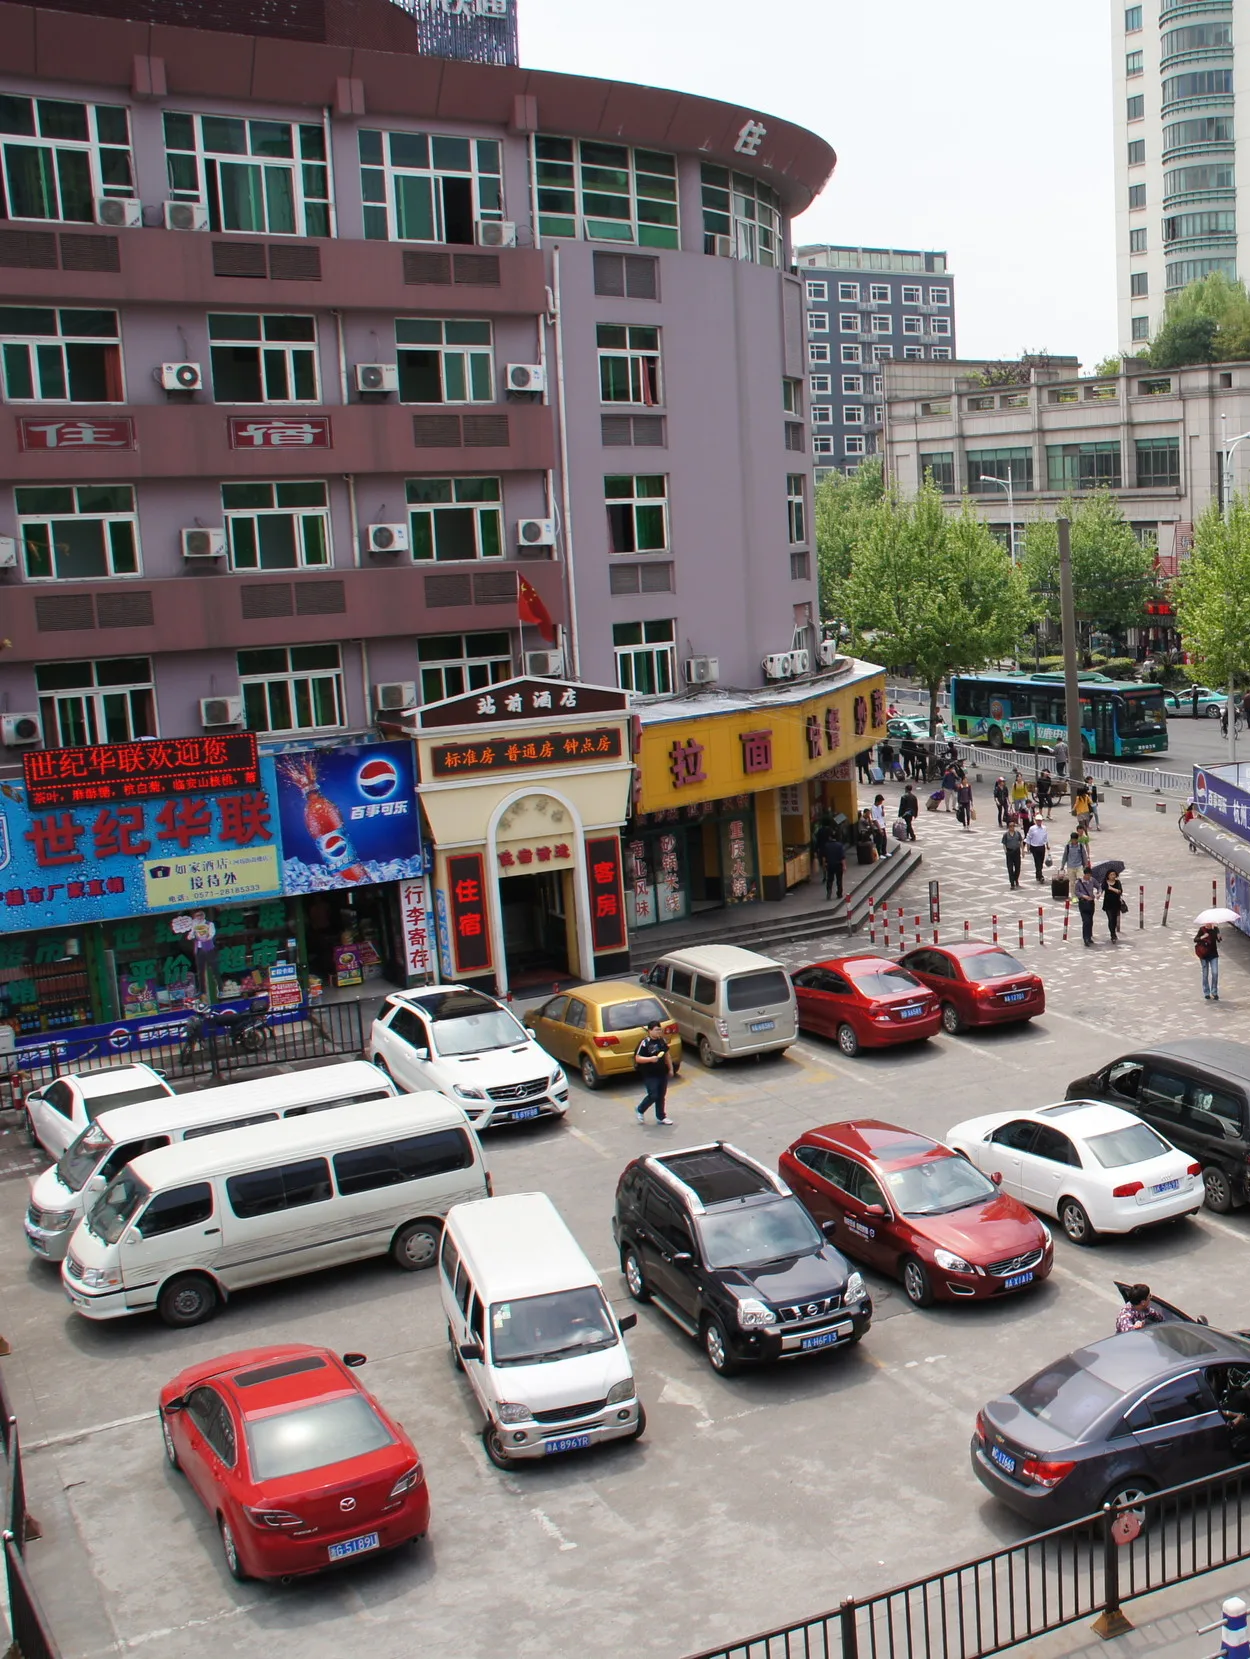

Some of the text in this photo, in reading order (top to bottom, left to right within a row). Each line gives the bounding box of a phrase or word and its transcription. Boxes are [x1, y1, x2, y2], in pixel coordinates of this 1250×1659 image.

[733, 119, 767, 155] 住
[28, 421, 323, 448] 住 宿
[477, 688, 578, 715] 站前酒店
[30, 739, 229, 782] 世纪华联欢迎您
[444, 735, 612, 768] 标准房 普通房 钟点房
[669, 730, 773, 788] 拉面
[24, 792, 273, 867] 世纪华联
[351, 800, 409, 820] 百事可乐
[175, 858, 228, 875] 如家酒店
[630, 840, 650, 917] 南北风味
[729, 820, 748, 897] 重庆火锅
[190, 872, 237, 891] 接待处
[593, 861, 617, 918] 客房
[405, 885, 429, 969] 行李寄存
[455, 879, 482, 937] 住宿
